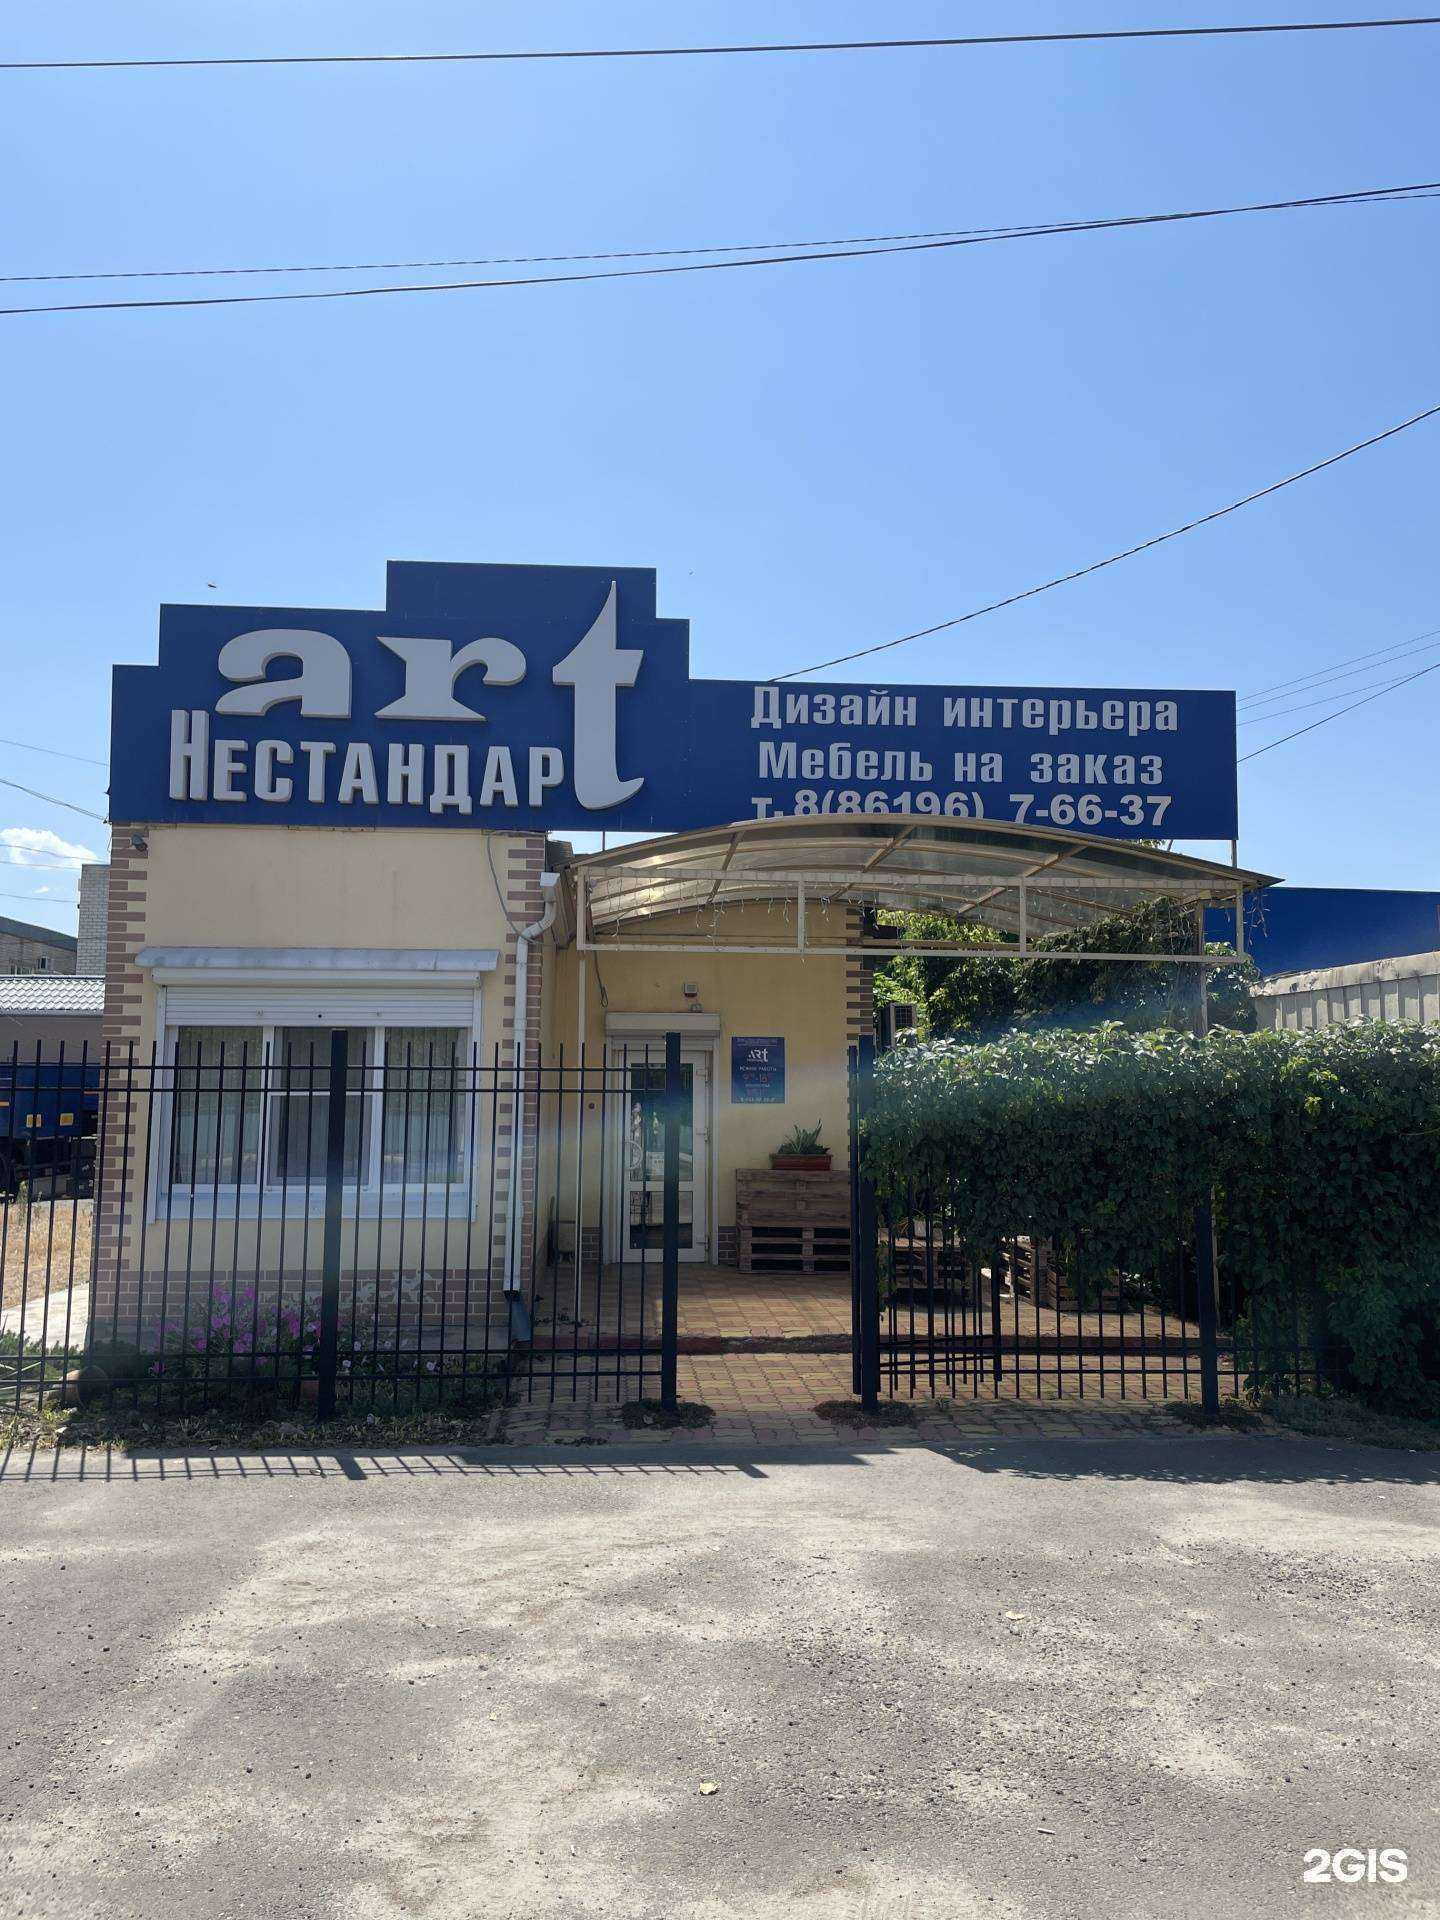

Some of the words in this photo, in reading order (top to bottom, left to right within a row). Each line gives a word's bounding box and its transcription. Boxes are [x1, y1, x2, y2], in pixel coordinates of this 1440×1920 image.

[213, 579, 646, 811] art
[750, 685, 918, 730] Дизайн
[942, 696, 1179, 737] интерьера
[757, 740, 934, 783] Мебель
[953, 751, 1004, 783] на
[1030, 752, 1164, 786] заказ
[793, 788, 985, 820] 8(86196)
[1008, 793, 1173, 827] 7-66-37
